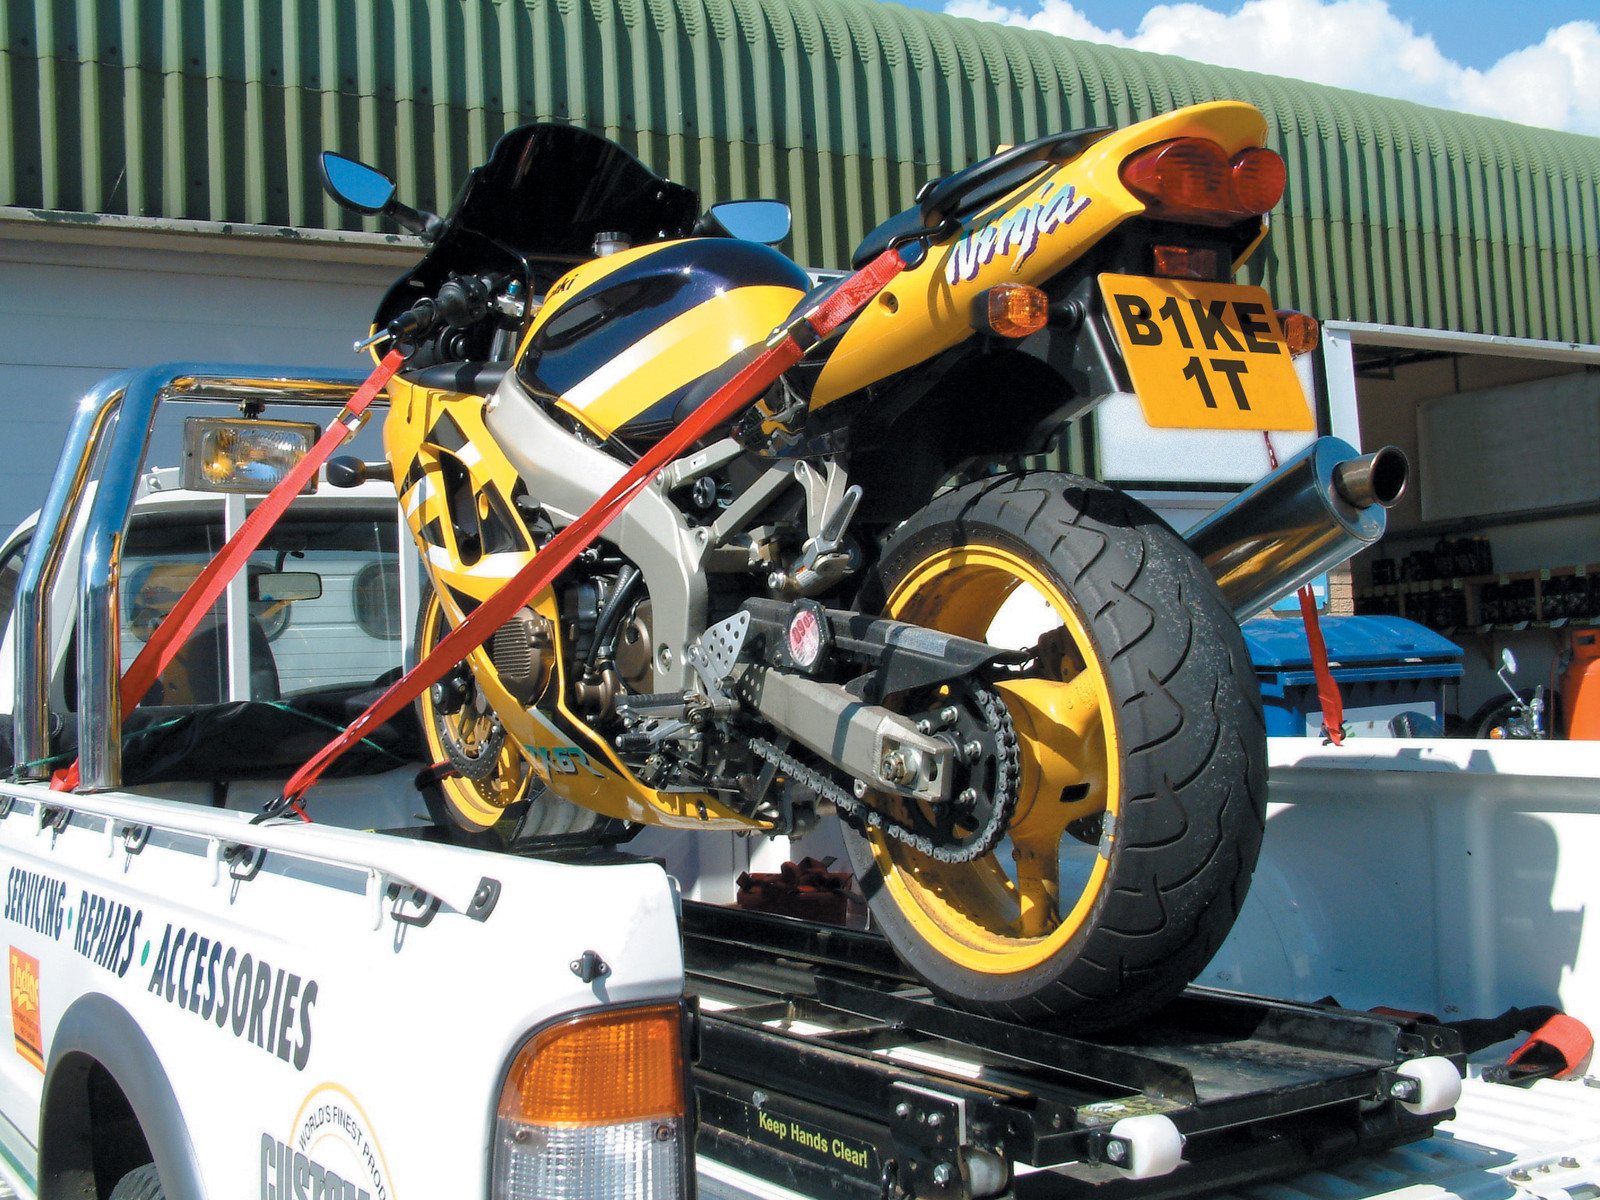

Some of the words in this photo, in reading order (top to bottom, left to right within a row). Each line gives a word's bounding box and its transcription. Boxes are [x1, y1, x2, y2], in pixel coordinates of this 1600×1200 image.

[944, 182, 1092, 286] Ninja
[1113, 293, 1282, 355] B1KE
[1182, 356, 1252, 411] 1T
[4, 866, 66, 941] SERVICING
[74, 890, 143, 978] REPAIRS
[148, 923, 318, 1071] ACCESSORIES
[298, 1104, 331, 1151] WORLD'S
[333, 1105, 363, 1146] FINEST
[758, 1110, 787, 1140] Keep
[790, 1122, 829, 1153] Hands
[832, 1139, 868, 1169] Clear!
